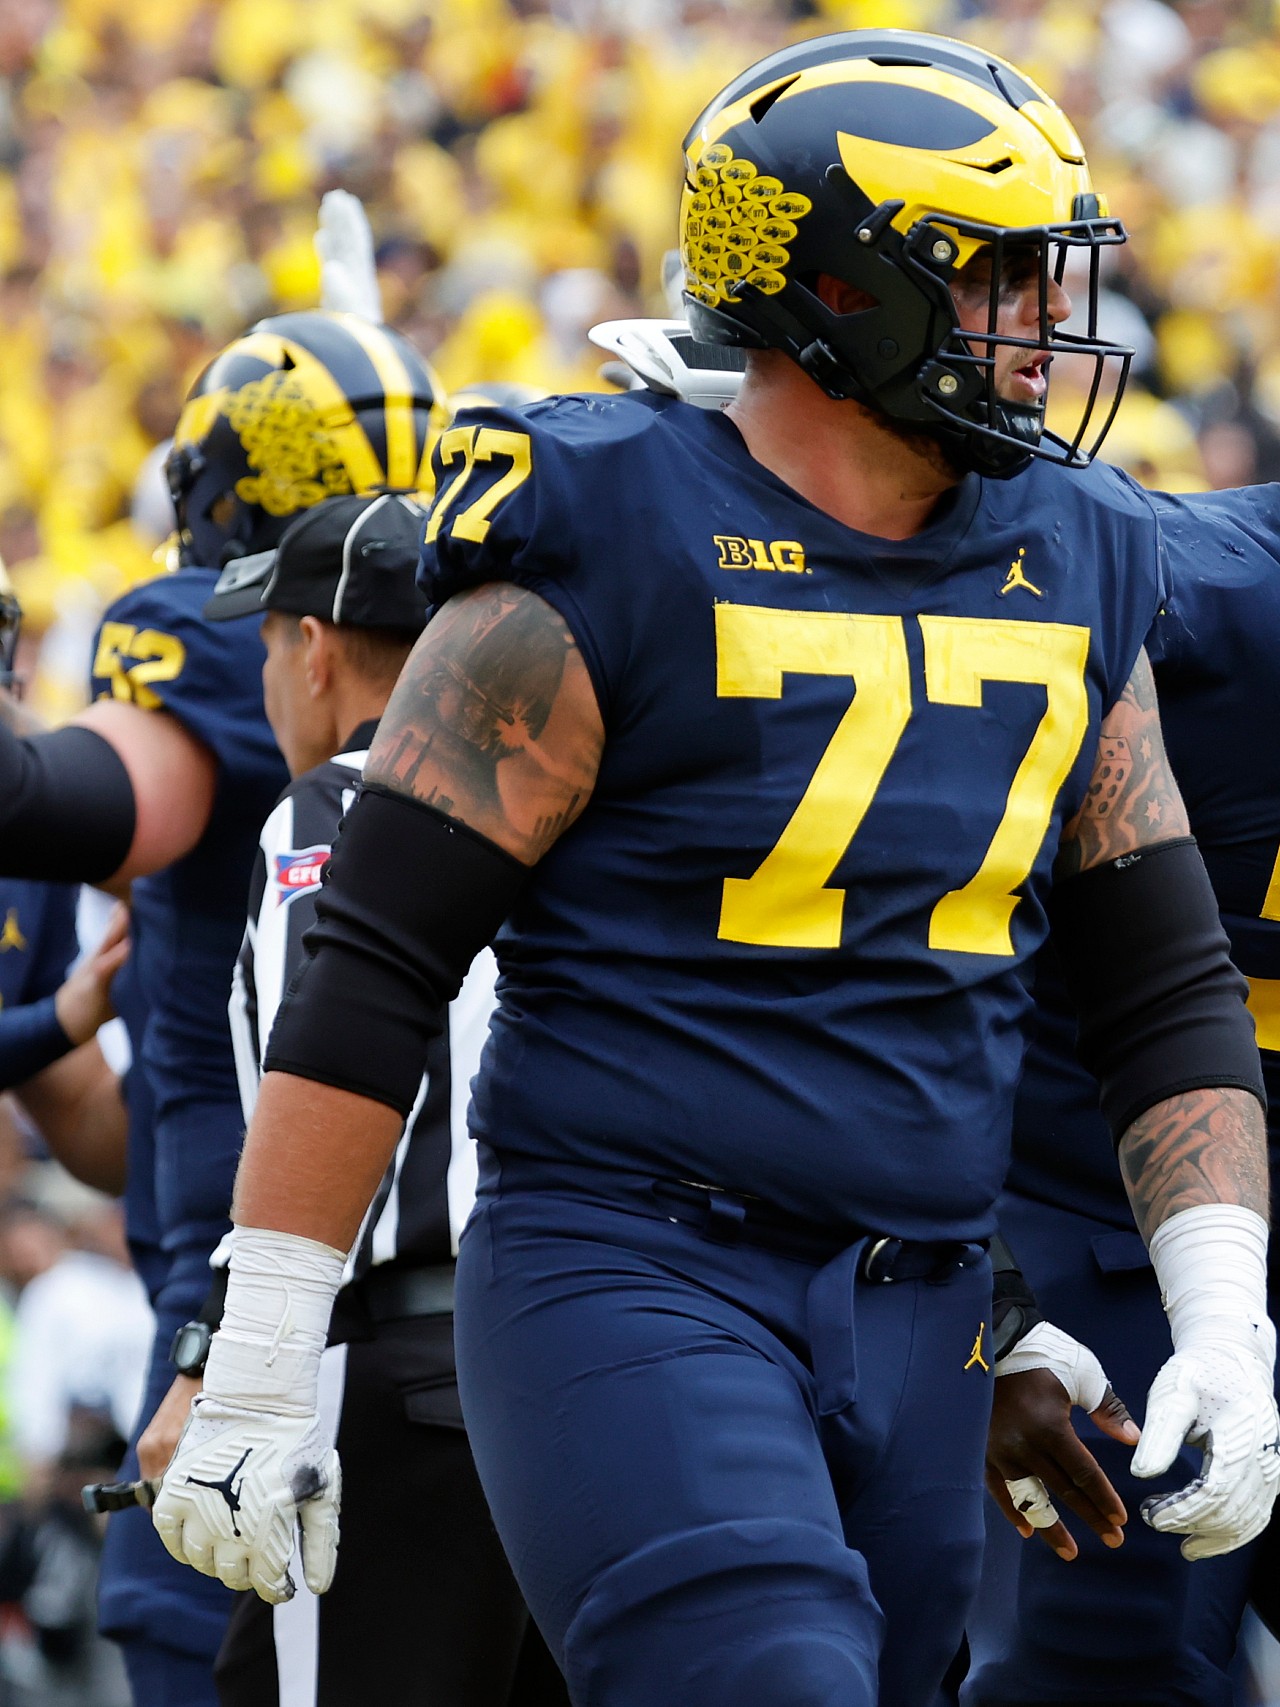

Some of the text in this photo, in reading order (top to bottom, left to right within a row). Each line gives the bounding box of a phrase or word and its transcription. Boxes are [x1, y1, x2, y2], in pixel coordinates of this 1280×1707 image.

[424, 424, 532, 544] 77
[93, 620, 186, 711] 52
[713, 602, 1091, 956] 77
